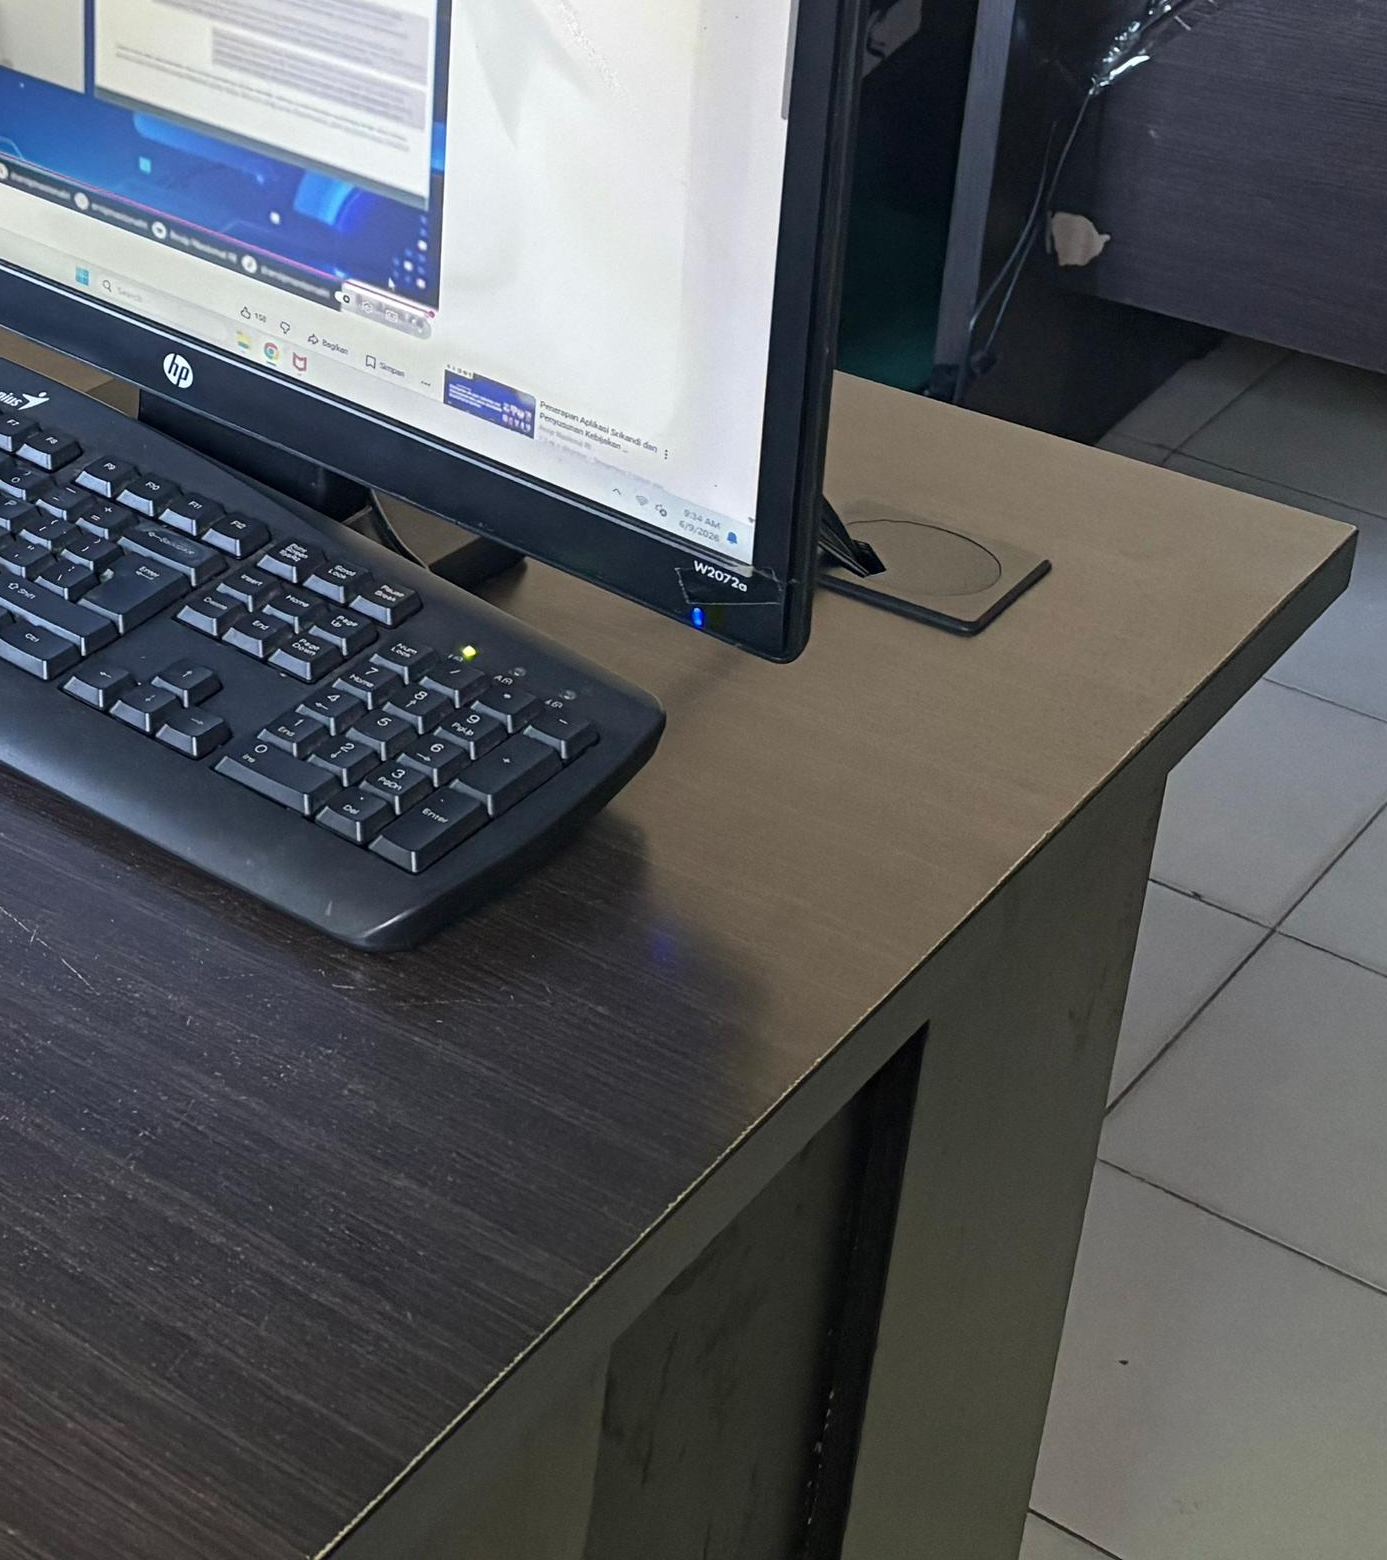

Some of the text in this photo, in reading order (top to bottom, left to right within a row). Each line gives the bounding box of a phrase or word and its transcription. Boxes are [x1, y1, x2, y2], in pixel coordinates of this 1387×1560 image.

[165, 353, 192, 388] hp
[540, 400, 579, 423] Penerapan
[580, 416, 610, 435] Aplikasi
[643, 440, 659, 452] dan
[704, 518, 721, 529] AM
[240, 573, 263, 587] Insert
[693, 560, 749, 594] W2072a
[285, 594, 309, 609] Home
[251, 619, 269, 632] End
[335, 614, 359, 629] Page
[292, 641, 317, 657] Down
[299, 637, 321, 653] Page
[391, 645, 413, 658] Lock
[396, 641, 418, 655] Num
[349, 673, 374, 690] Home
[327, 693, 340, 704] 4
[414, 691, 428, 702] 8
[377, 716, 392, 728] 5
[466, 714, 481, 725] 9
[277, 725, 296, 738] End
[451, 721, 475, 738] PgUp
[340, 742, 356, 753] 2
[429, 742, 445, 754] 6
[391, 768, 406, 780] 3
[377, 776, 403, 793] PgDn
[342, 802, 360, 816] Del
[421, 807, 449, 826] Enter
